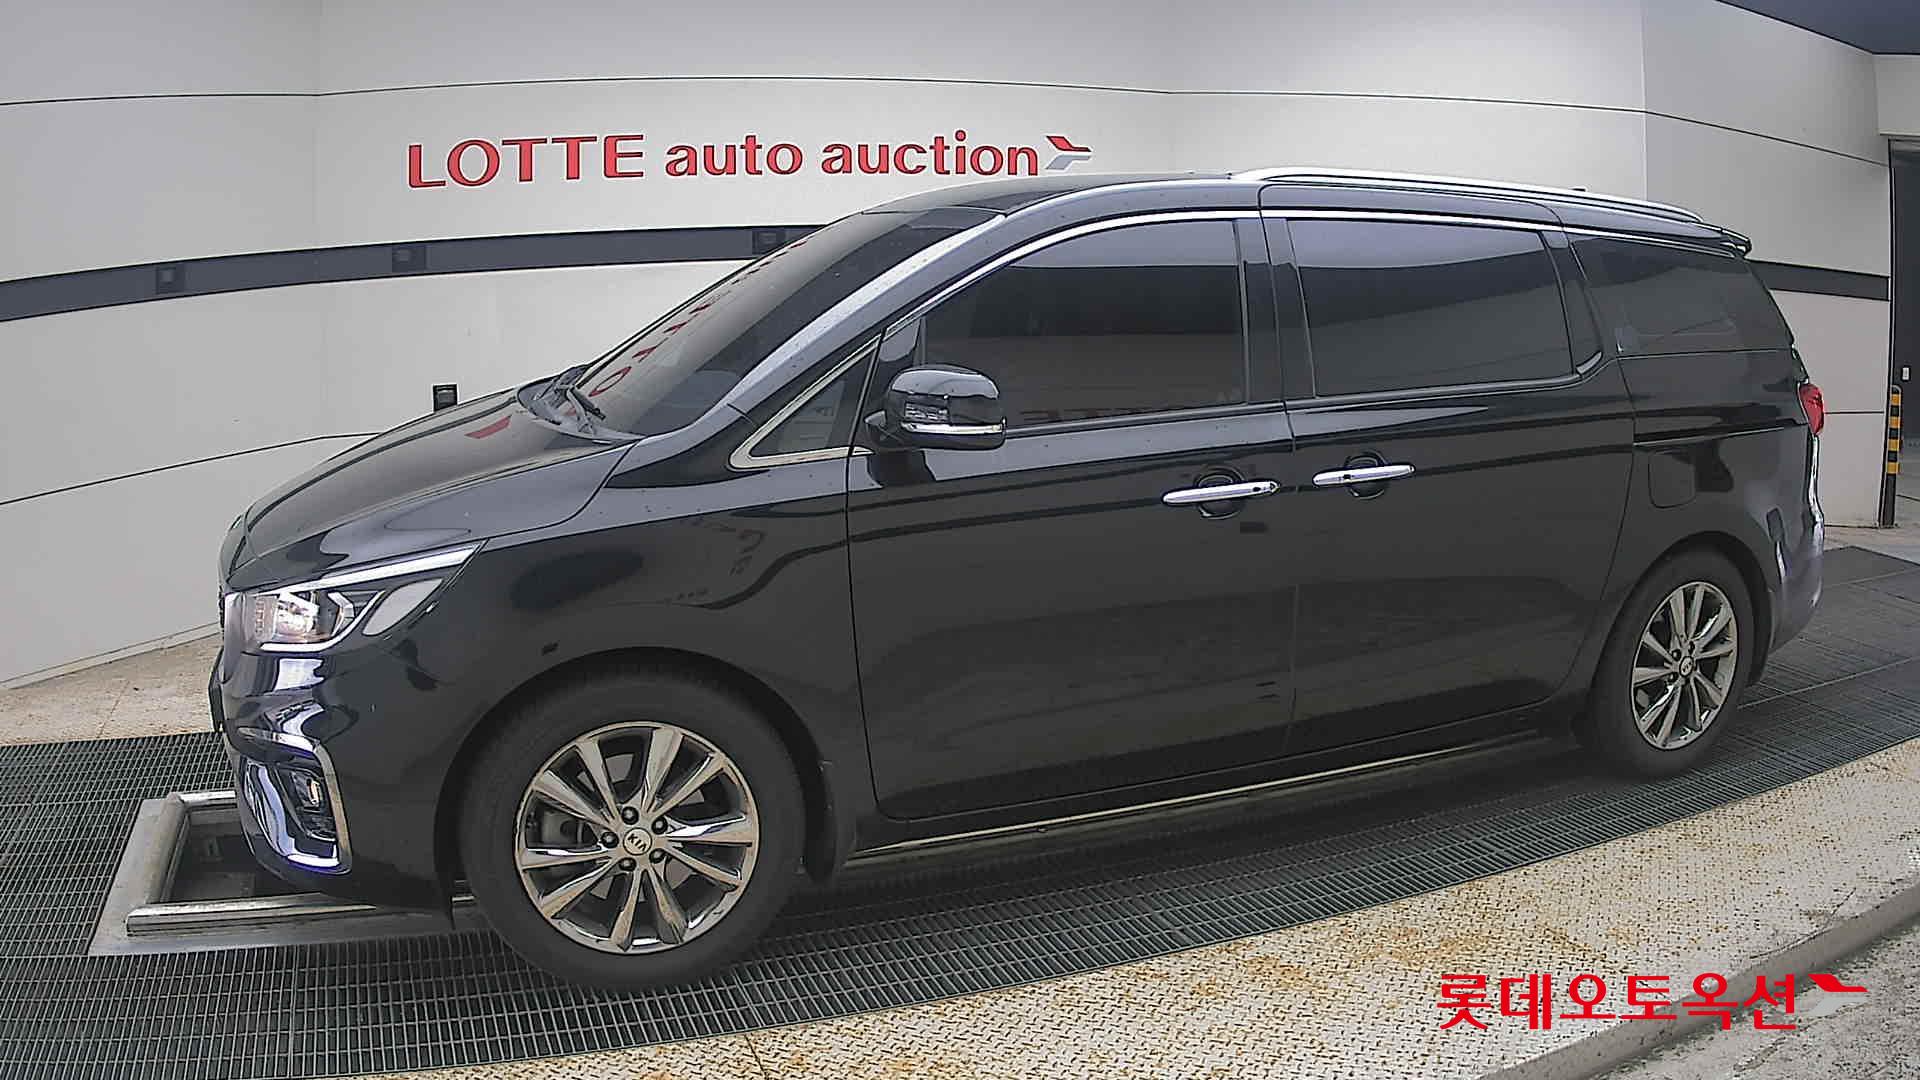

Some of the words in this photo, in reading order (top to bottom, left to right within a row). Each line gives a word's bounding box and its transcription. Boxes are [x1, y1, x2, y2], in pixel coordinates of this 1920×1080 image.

[408, 134, 645, 189] LOTTE
[665, 134, 803, 177] auto
[822, 131, 1039, 177] auction
[627, 833, 648, 852] KIA
